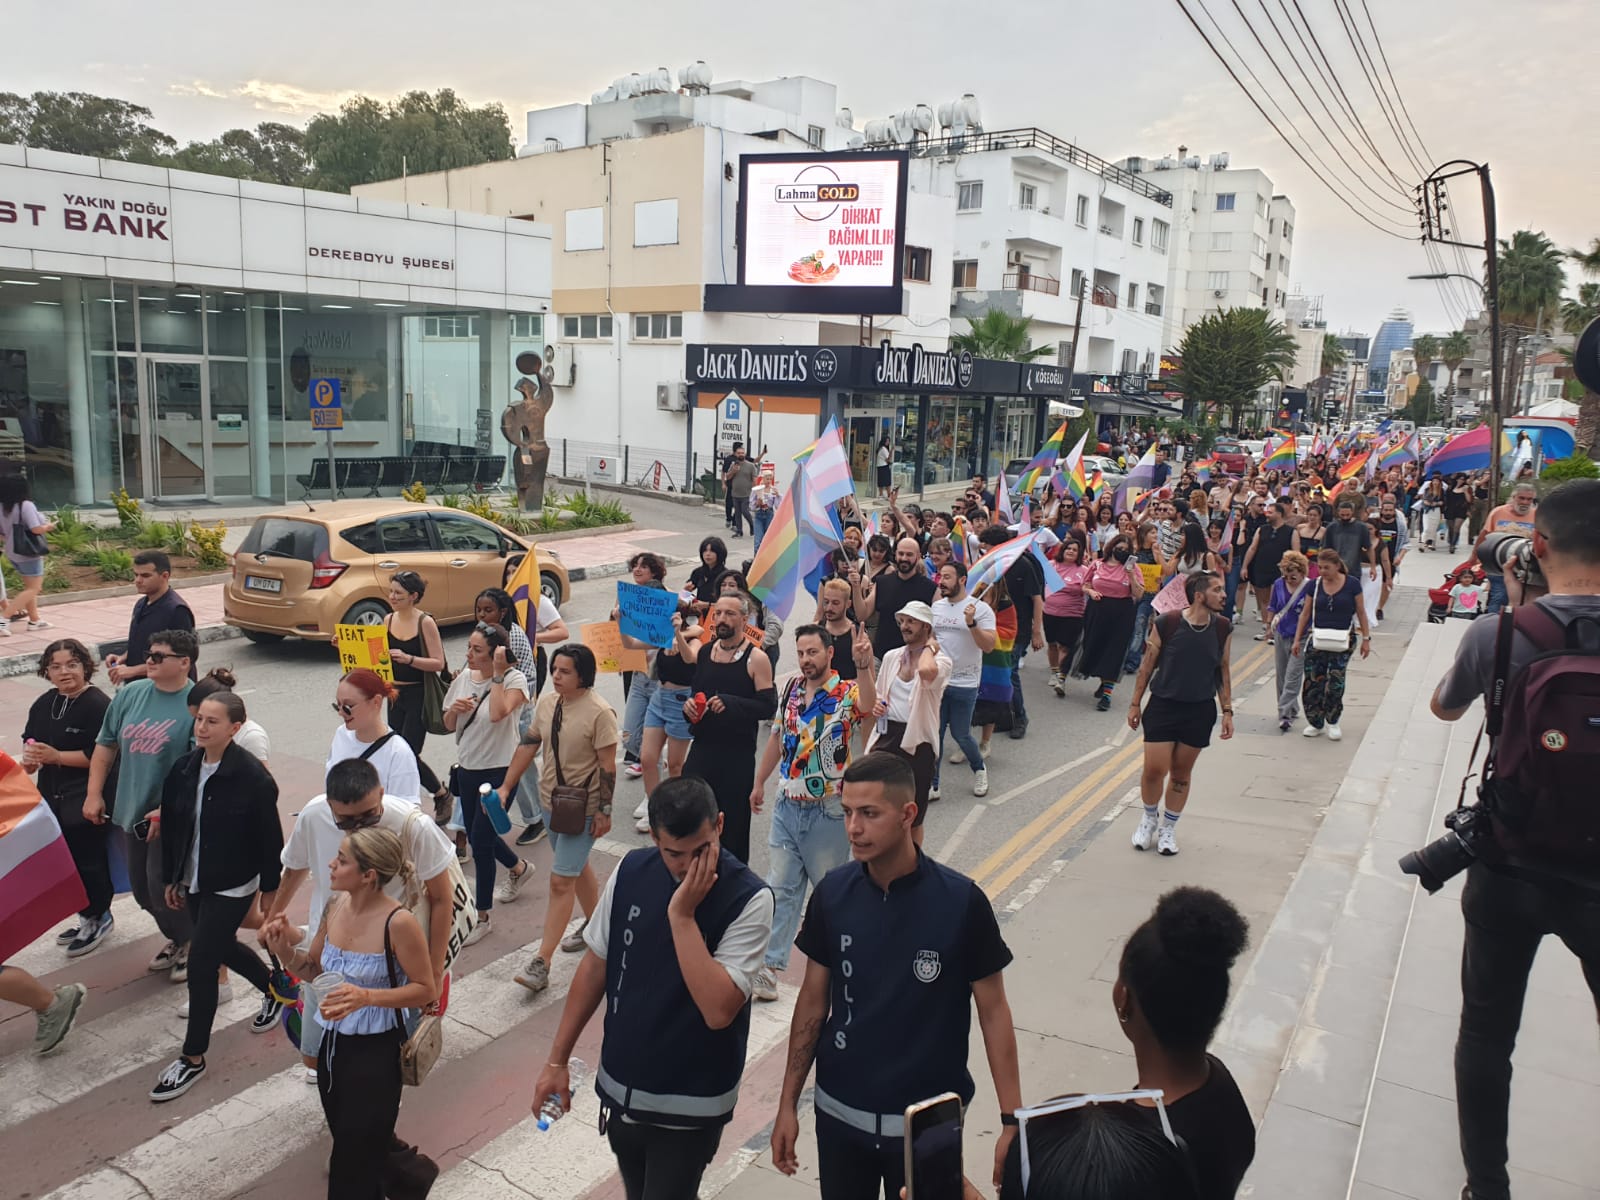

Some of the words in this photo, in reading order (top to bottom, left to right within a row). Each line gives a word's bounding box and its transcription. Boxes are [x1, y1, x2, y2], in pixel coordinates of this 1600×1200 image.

[63, 193, 116, 210] YAKIN
[122, 201, 168, 216] DOĞU
[777, 188, 816, 200] Lahma
[818, 186, 858, 200] GOLD
[64, 208, 169, 241] BANK
[842, 205, 882, 224] DİKKAT
[308, 247, 394, 264] DEREBOYU
[402, 256, 454, 271] ŞUBESİ
[838, 250, 883, 266] YAPAR!!!
[696, 347, 738, 379] JACK
[740, 348, 808, 382] DANIEL'S
[876, 342, 910, 383] JACK
[913, 346, 957, 386] DANIEL'S
[345, 628, 365, 642] EAT
